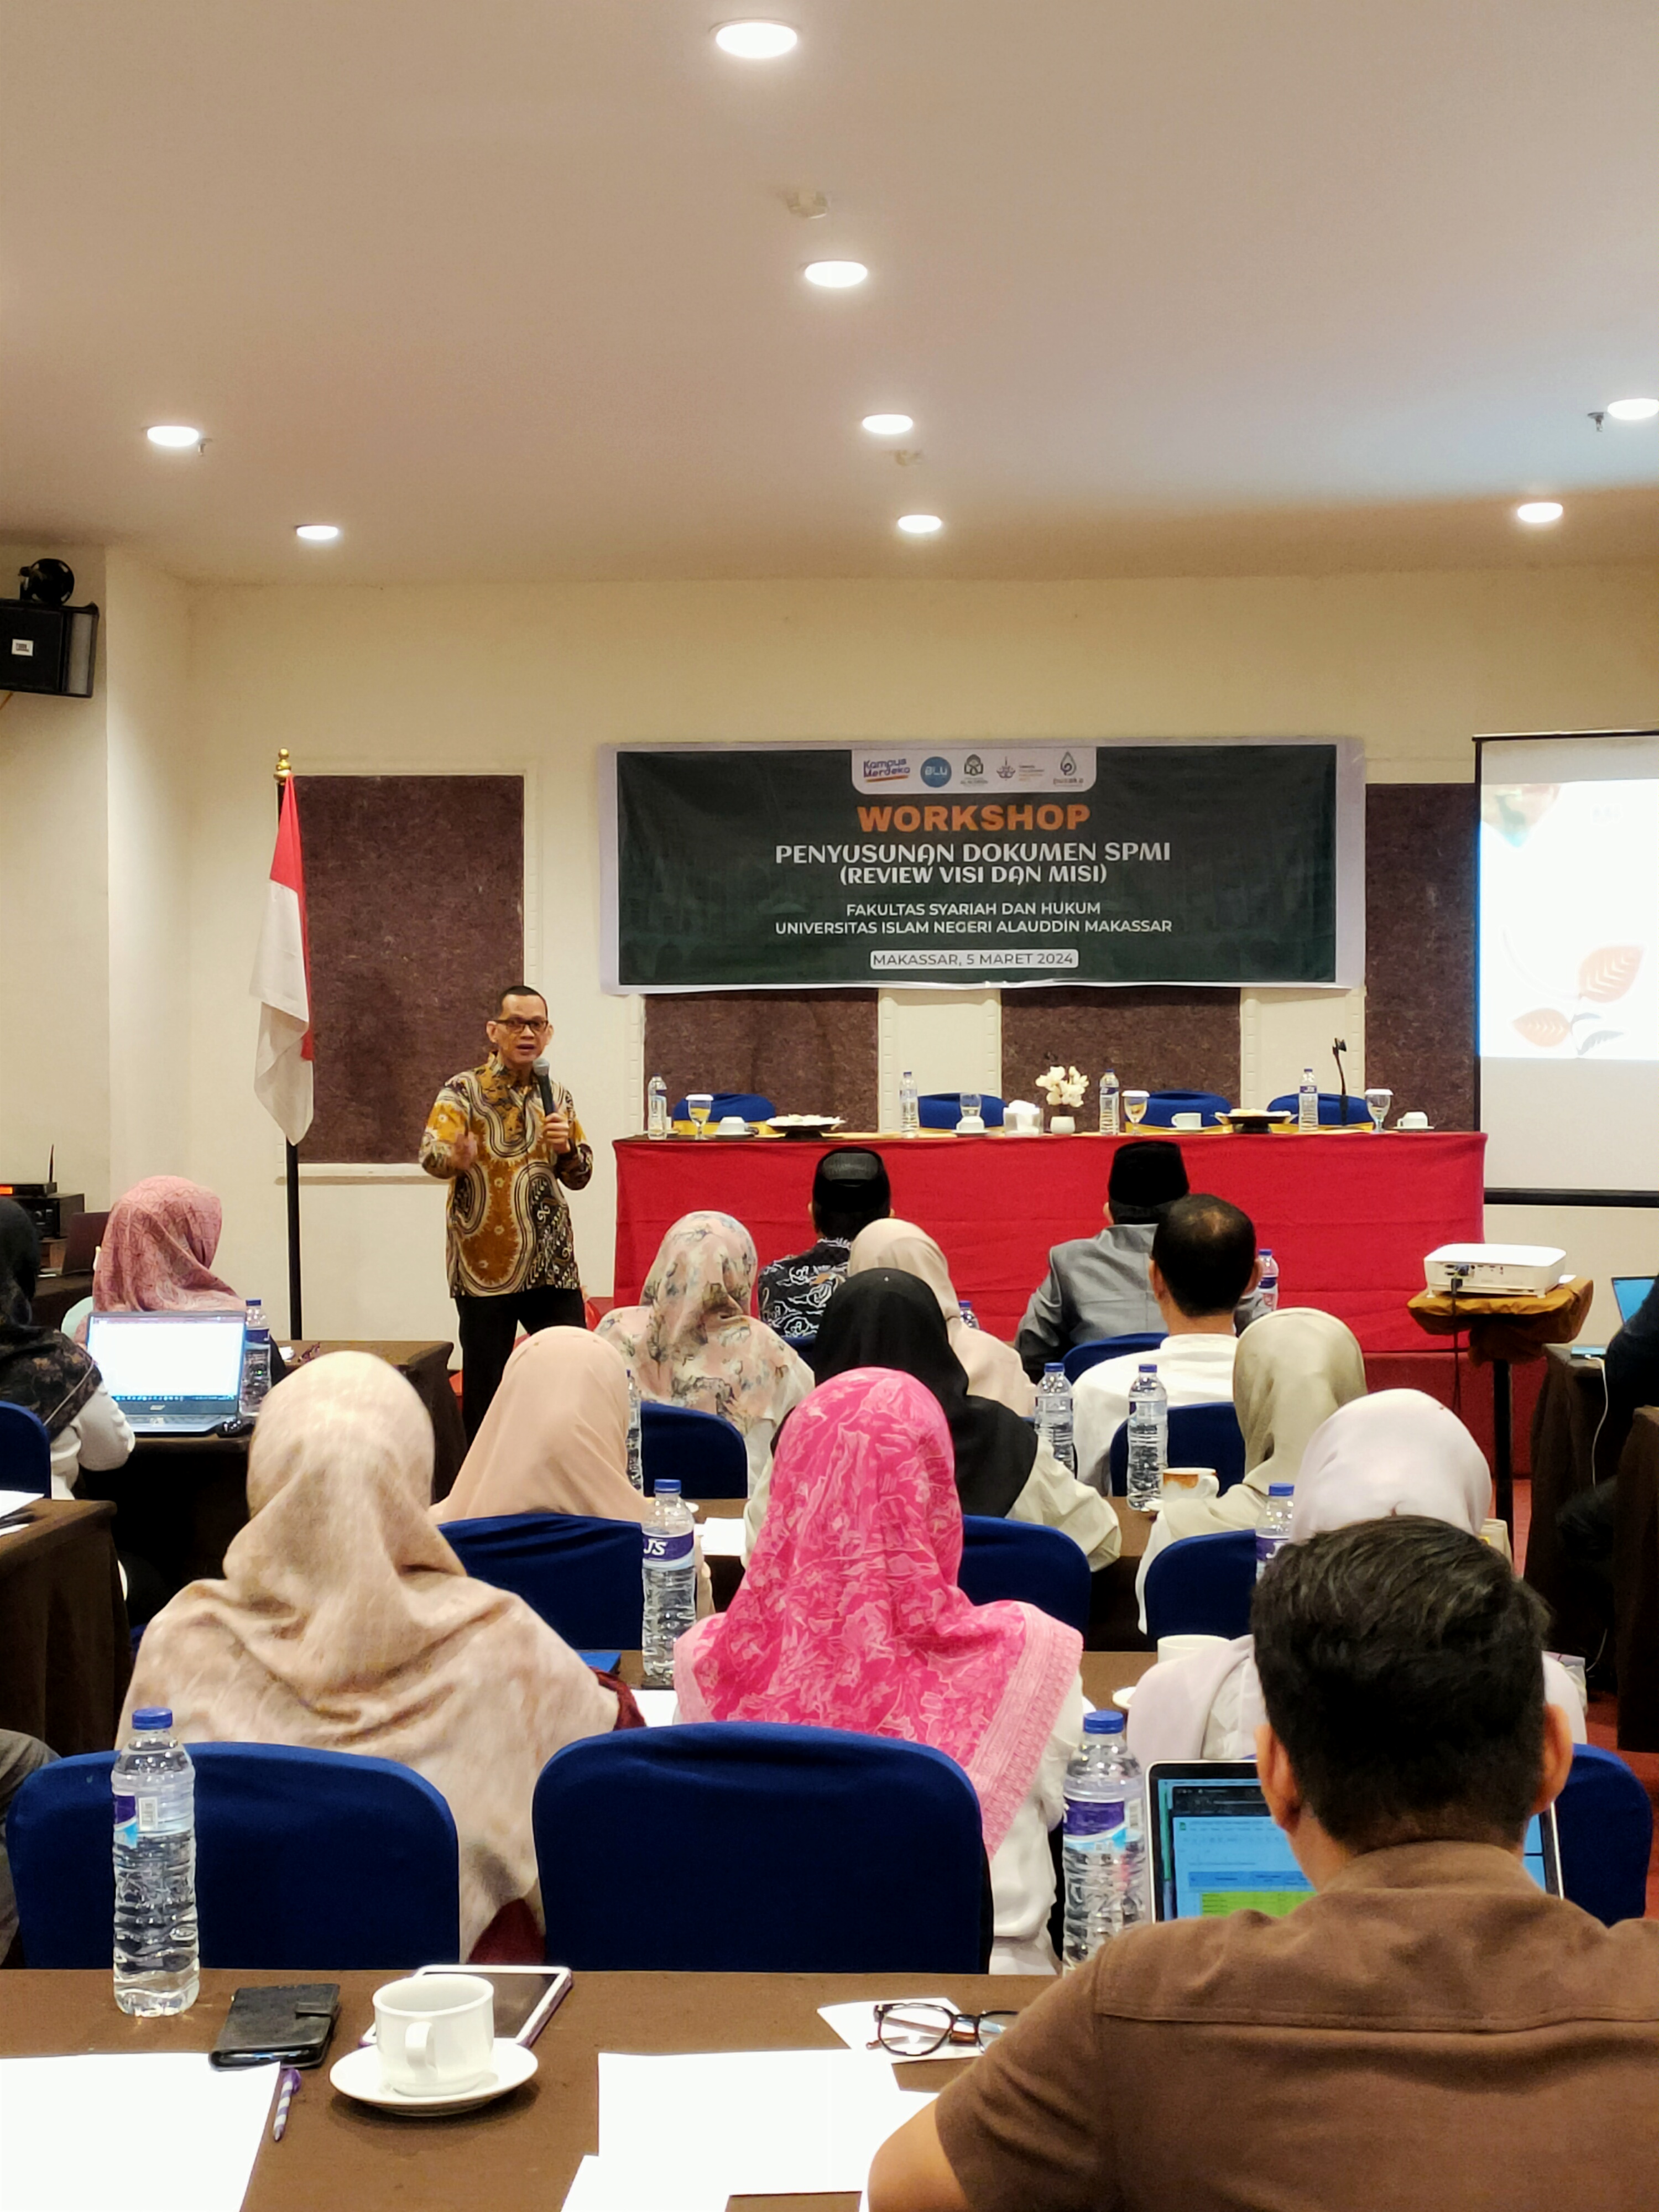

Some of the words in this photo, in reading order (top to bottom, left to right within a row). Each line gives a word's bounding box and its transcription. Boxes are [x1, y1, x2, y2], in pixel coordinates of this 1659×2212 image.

[863, 758, 907, 770] Kampus
[925, 766, 948, 776] BLU
[863, 766, 911, 778] Merdeka
[858, 805, 1089, 832] WORKSHOP
[776, 843, 954, 865] PENYUSUNAN
[963, 843, 1096, 862] DOKUMEN
[1105, 842, 1171, 861] SPMI
[840, 865, 933, 885] (REVIEW
[940, 866, 984, 884] VISI
[992, 865, 1041, 885] DAN
[1048, 863, 1107, 884] MISI)
[847, 904, 925, 916] FAKULTAS
[929, 903, 997, 916] SYARIAH
[1002, 902, 1036, 915] DAN
[1041, 902, 1100, 915] HUKUM
[776, 922, 878, 935] UNIVERSITAS
[882, 921, 929, 934] ISLAM
[934, 920, 992, 933] NEGERI
[996, 920, 1080, 933] ALAUDDIN
[1085, 920, 1172, 933] MAKASSAR
[873, 954, 962, 967] MAKASSAR,
[967, 954, 975, 965] 5
[979, 953, 1033, 964] MARET
[1037, 953, 1073, 964] 2024
[643, 1540, 667, 1556] JS
[1266, 1542, 1284, 1558] J
